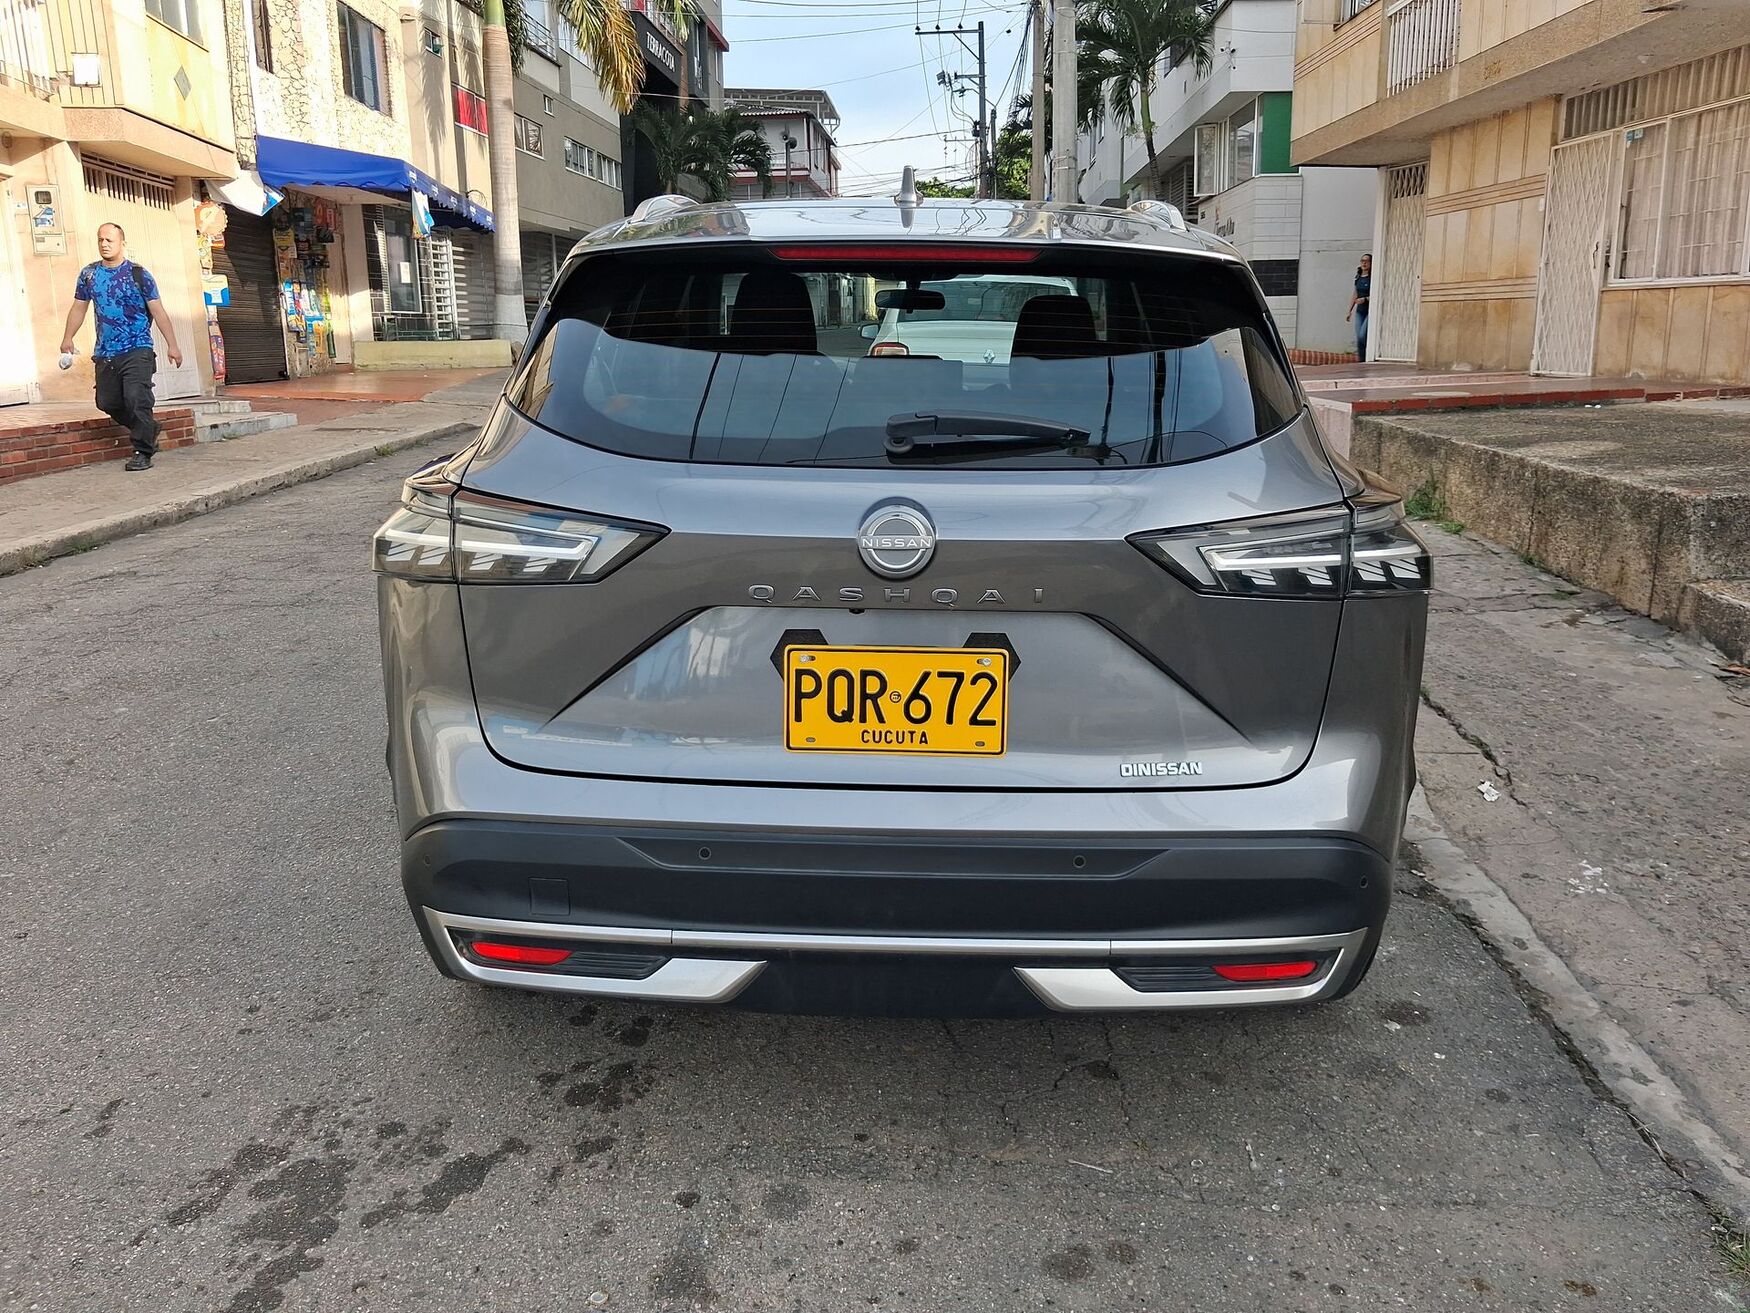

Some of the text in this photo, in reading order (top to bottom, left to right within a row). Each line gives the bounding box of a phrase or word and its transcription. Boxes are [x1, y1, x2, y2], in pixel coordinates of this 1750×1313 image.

[862, 538, 931, 548] NISSAN
[748, 584, 1043, 606] QASHQAI
[861, 729, 928, 744] CUCUTA
[1120, 762, 1203, 777] DINISSAN
